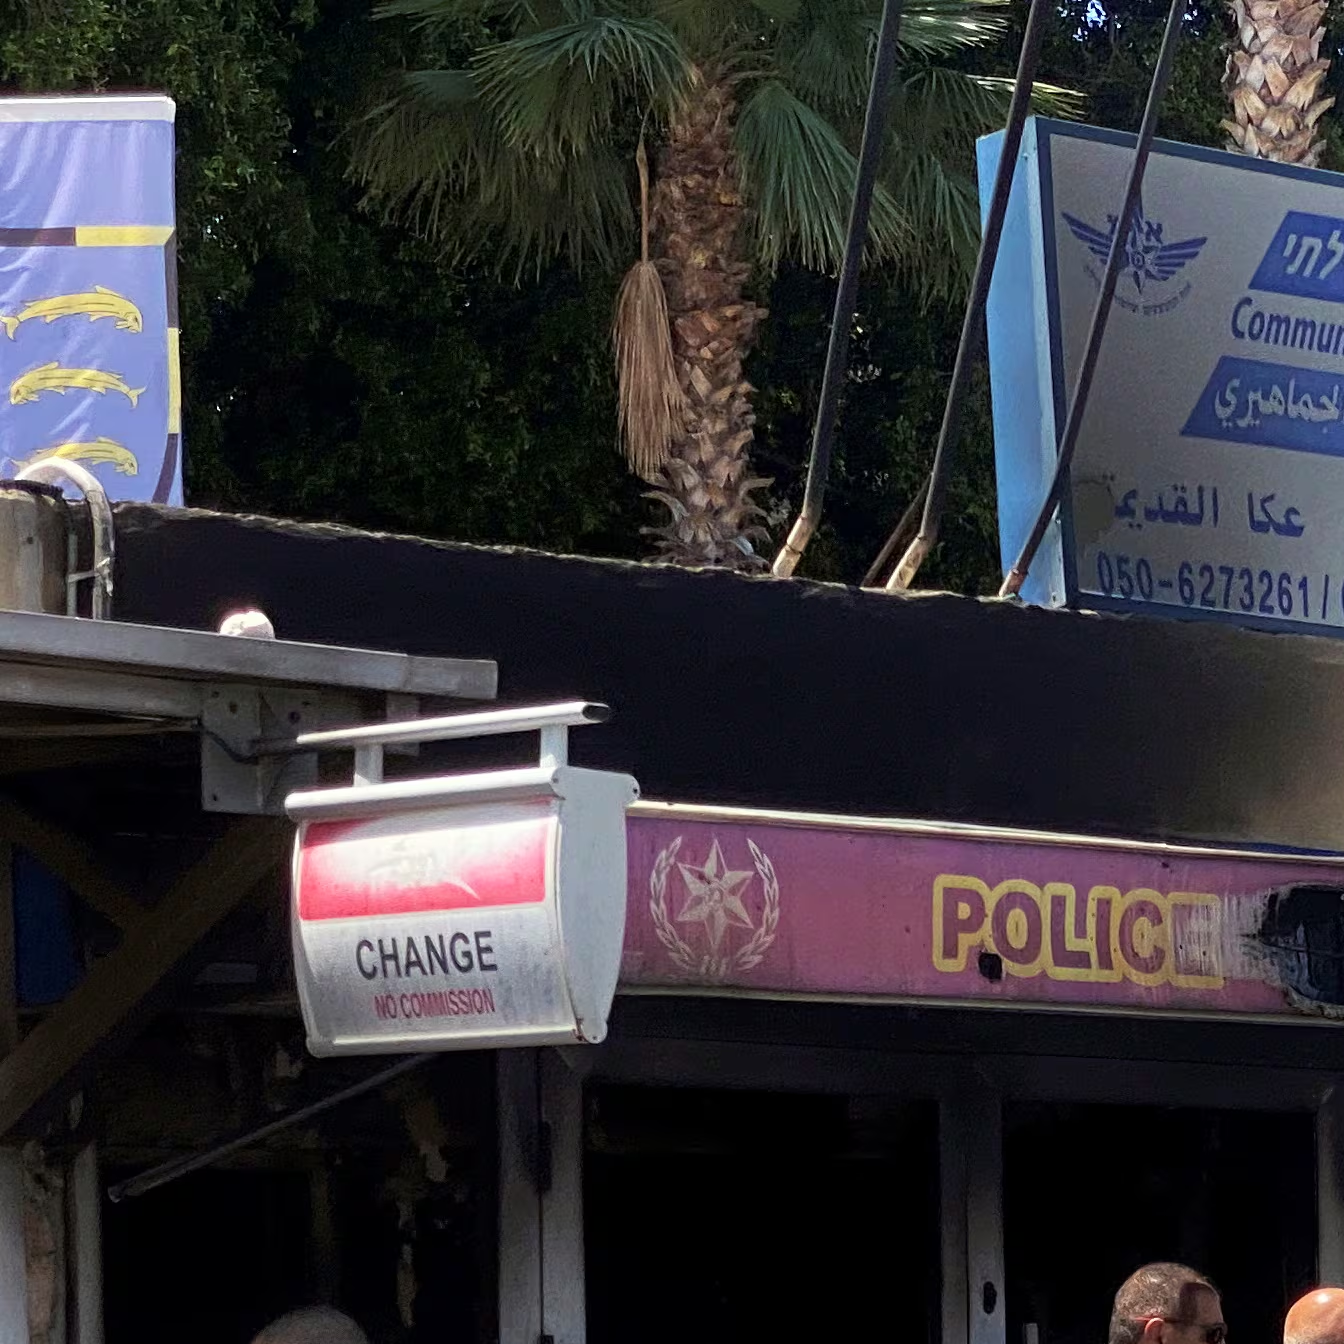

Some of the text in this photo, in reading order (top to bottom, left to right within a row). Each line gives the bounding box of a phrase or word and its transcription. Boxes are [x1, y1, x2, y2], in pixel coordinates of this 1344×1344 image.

[1102, 473, 1305, 538] عكا القديم
[1096, 551, 1310, 618] 050-6273261
[355, 930, 499, 981] CHANGE
[374, 988, 496, 1021] NO COMMISSION
